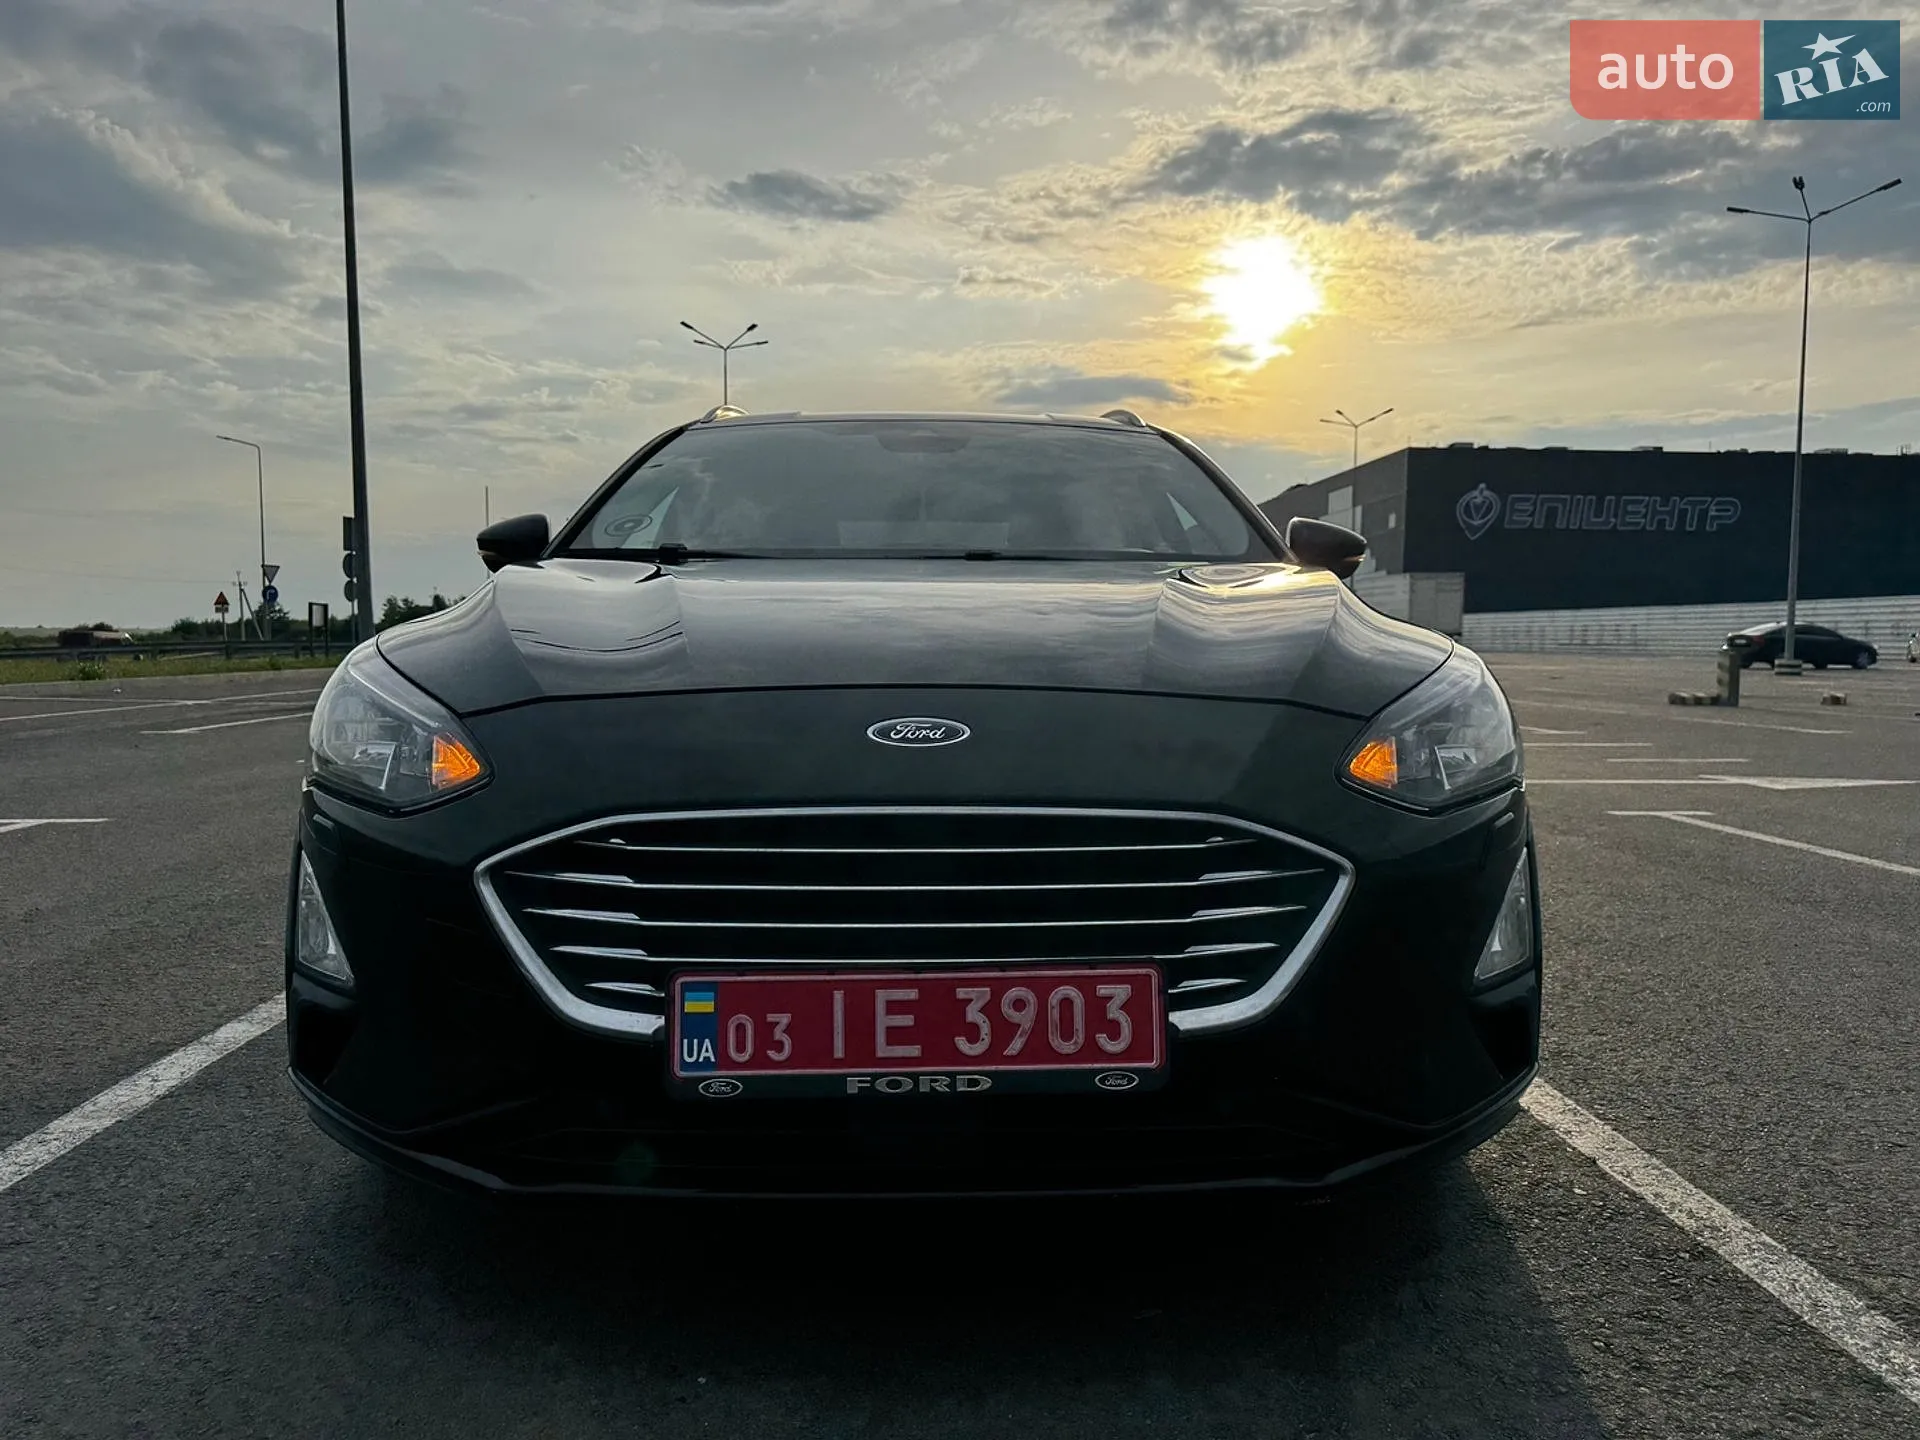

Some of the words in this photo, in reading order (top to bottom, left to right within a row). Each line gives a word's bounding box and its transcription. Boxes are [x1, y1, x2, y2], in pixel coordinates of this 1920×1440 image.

[1503, 493, 1742, 532] ЕПІЦЕНТР
[890, 722, 946, 739] Ford
[727, 1013, 792, 1063] 03
[833, 988, 922, 1059] IE
[954, 984, 1133, 1057] 3903
[682, 1038, 716, 1063] UA
[846, 1074, 993, 1094] FORD
